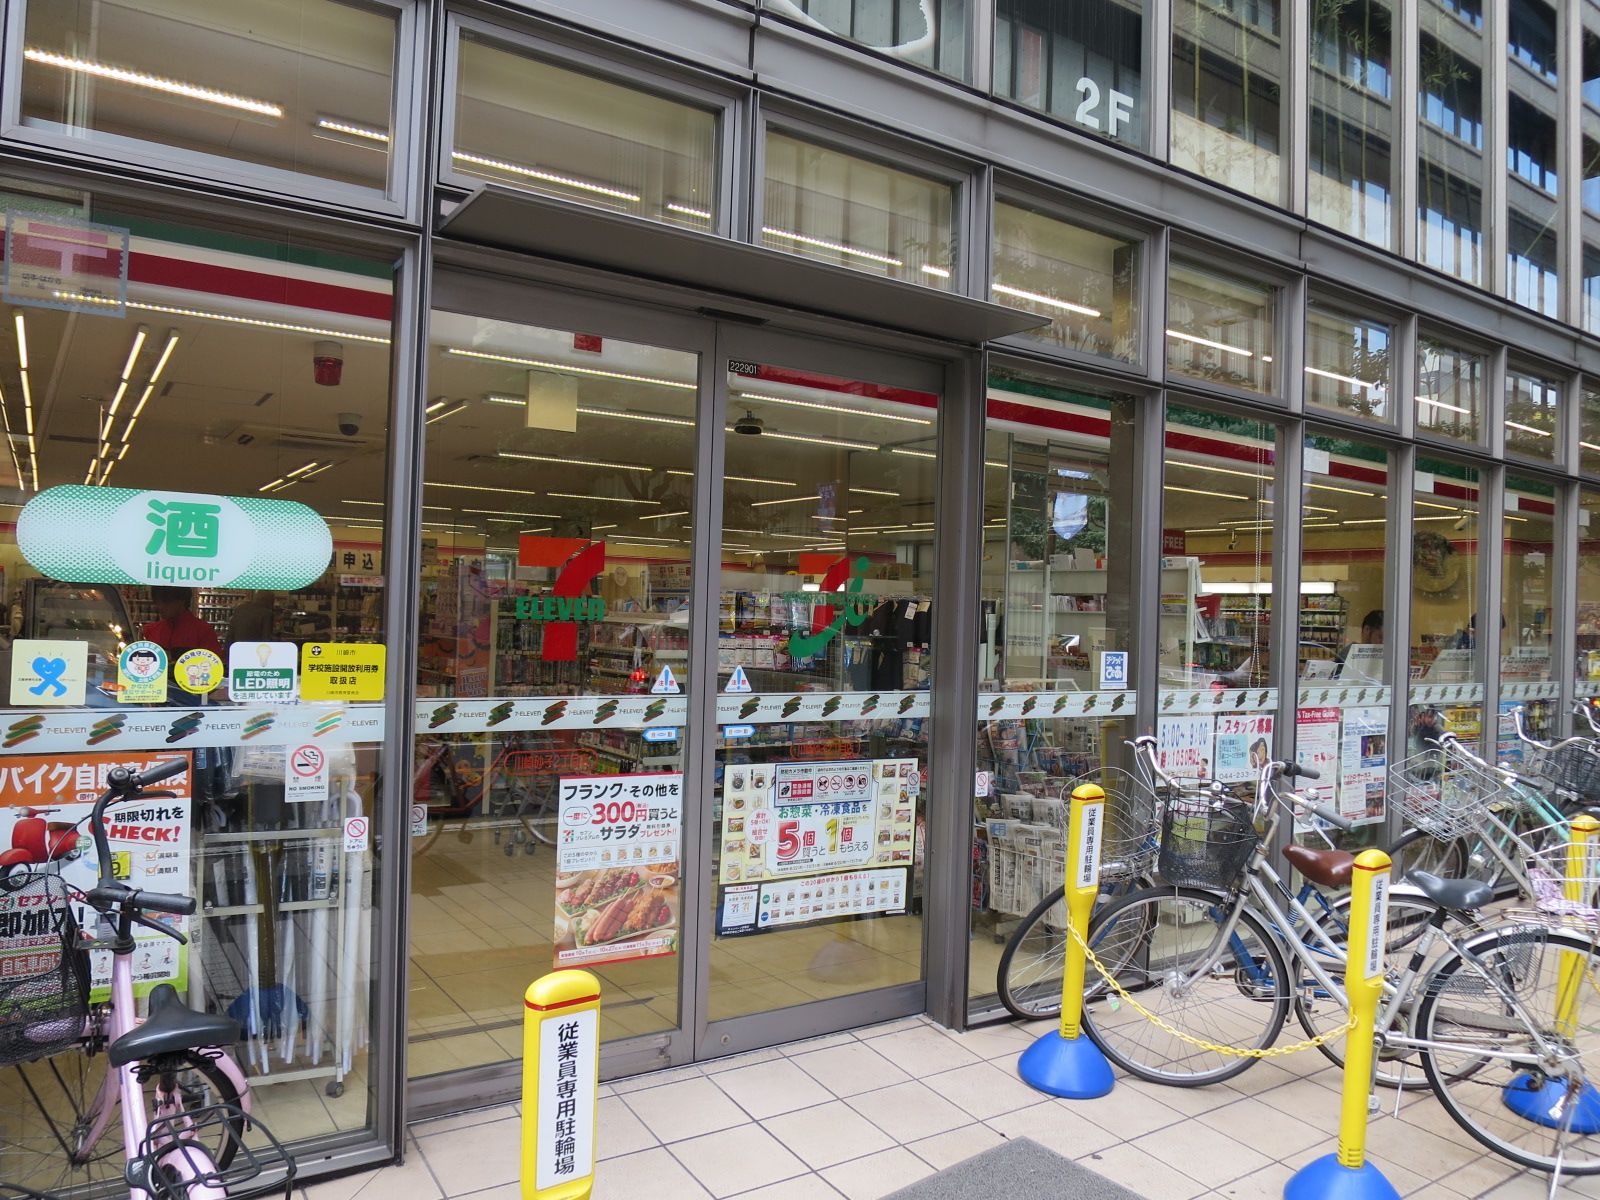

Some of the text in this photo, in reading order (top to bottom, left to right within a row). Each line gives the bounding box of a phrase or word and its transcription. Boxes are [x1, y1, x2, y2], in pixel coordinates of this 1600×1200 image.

[1075, 77, 1134, 137] 2F
[729, 361, 757, 375] 222901
[146, 499, 221, 558] 酒
[146, 561, 219, 583] liquor
[235, 678, 291, 690] LED照明
[330, 676, 357, 685] 取扱店
[563, 782, 679, 801] フランク・その他を
[114, 807, 184, 824] 期限切れを
[600, 824, 642, 841] サラダ
[802, 845, 827, 858] 買うと
[839, 842, 869, 853] もらえる
[1083, 807, 1097, 883] 従業員専用駐輪場
[553, 1020, 580, 1176] 従業員専用駐輪場
